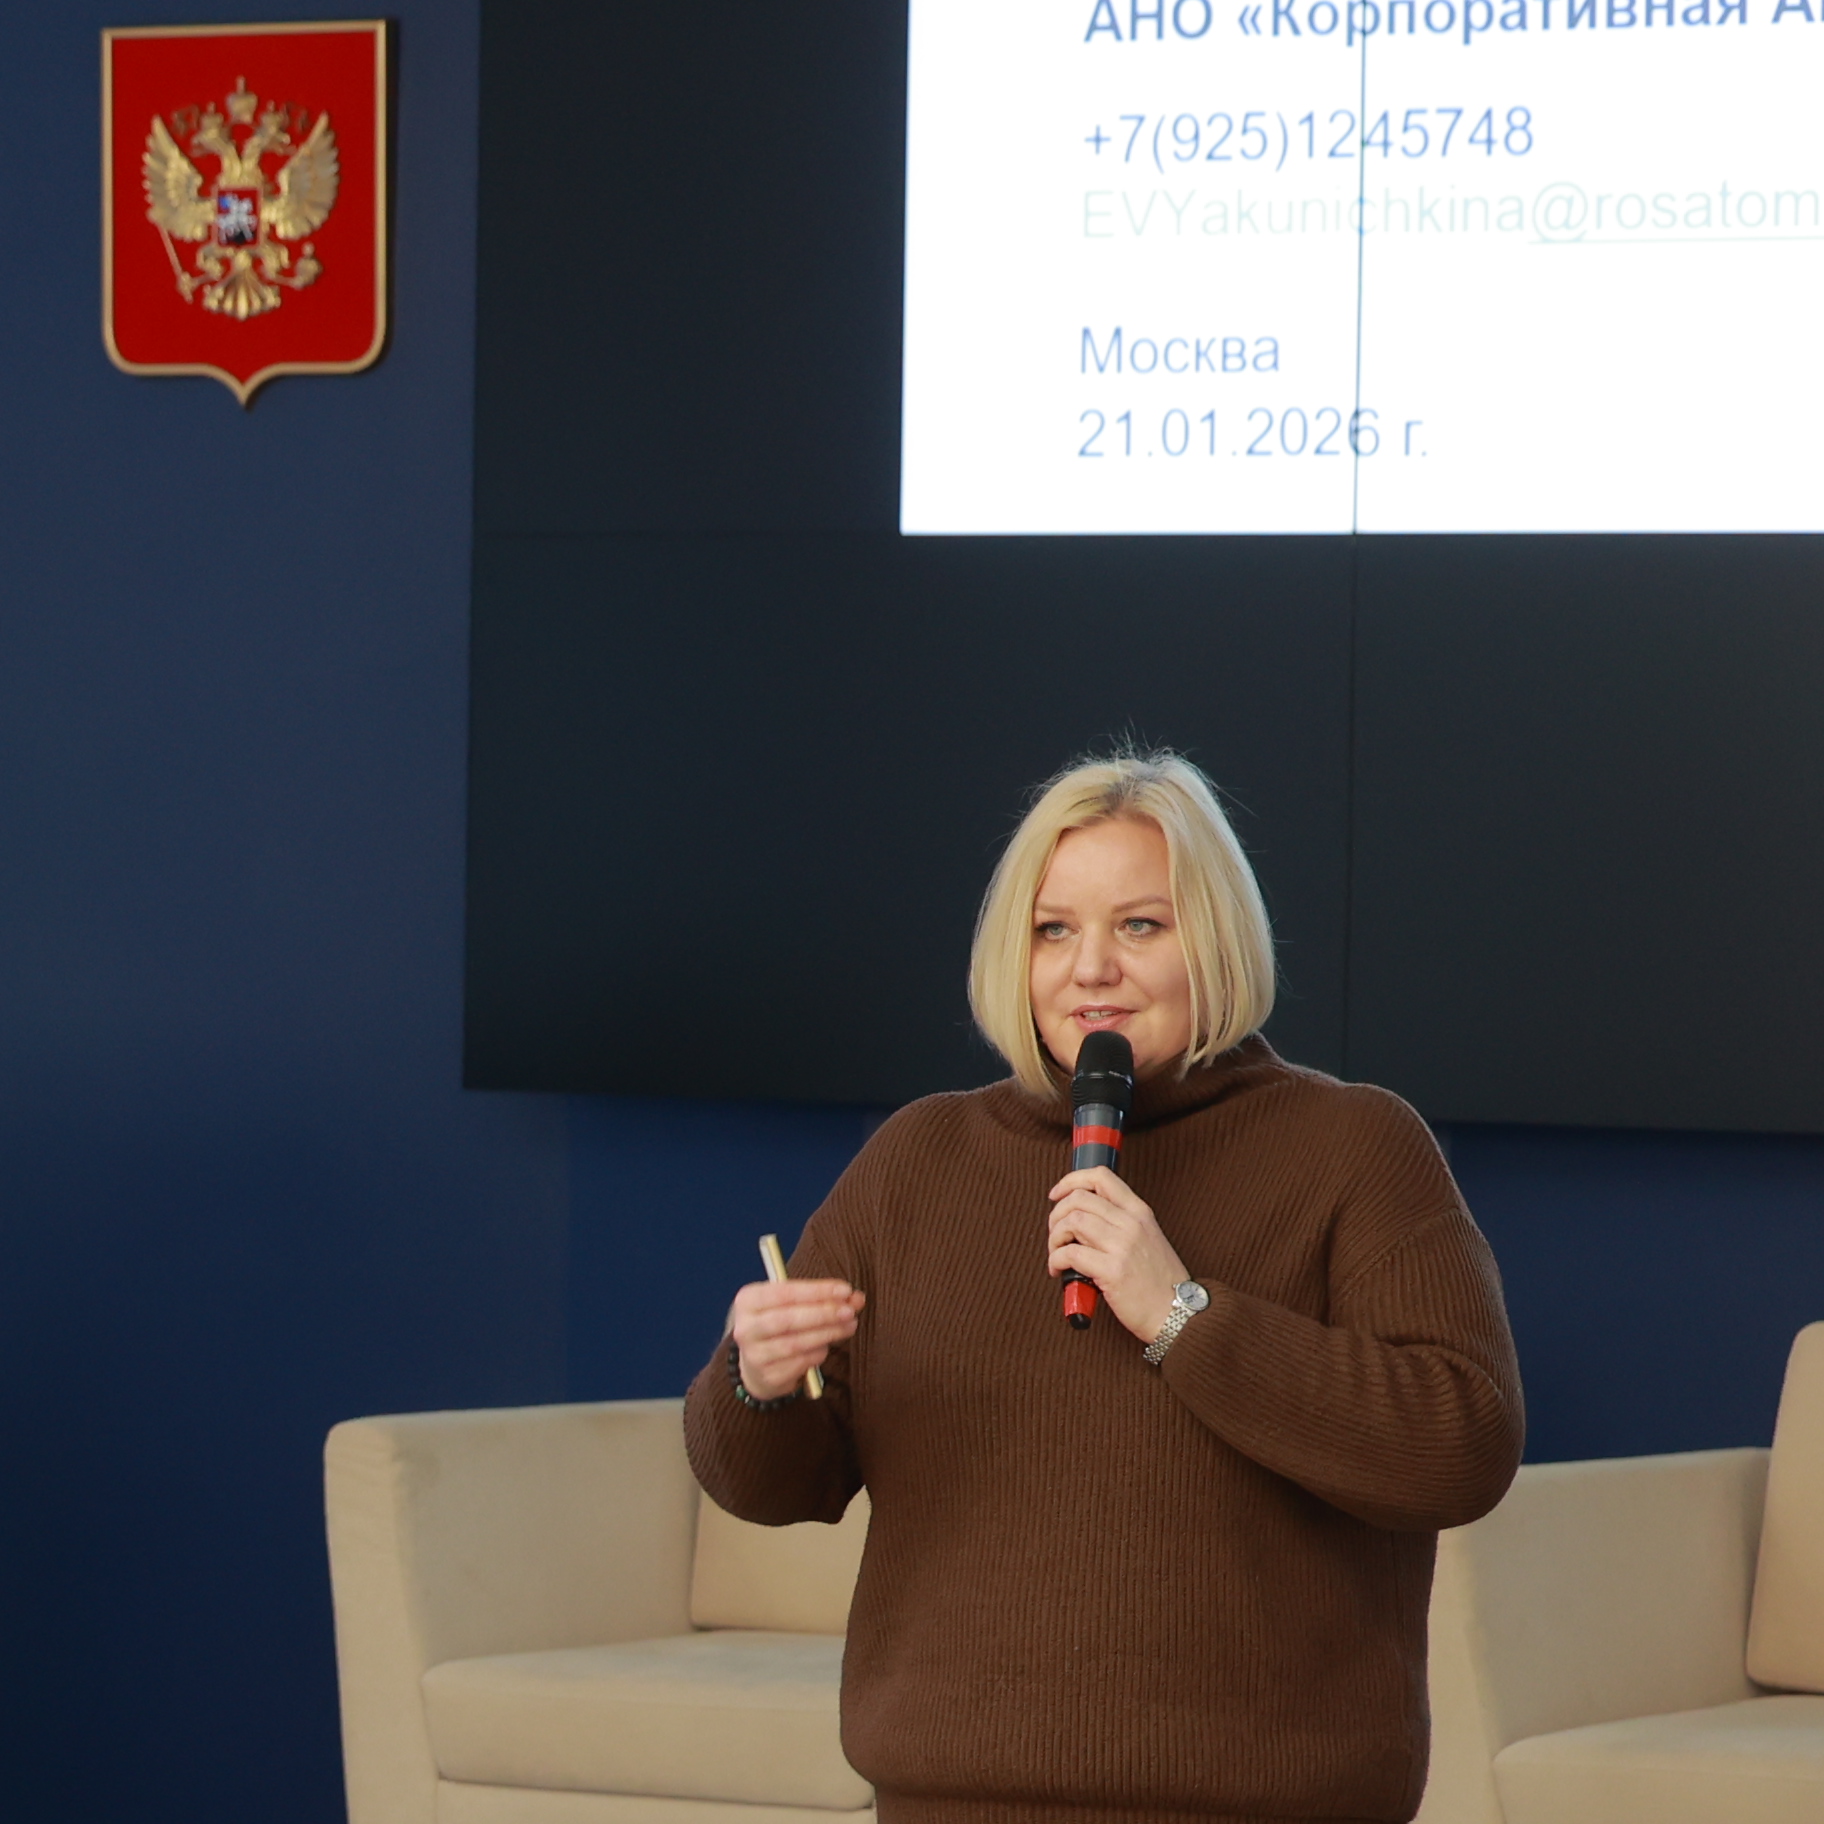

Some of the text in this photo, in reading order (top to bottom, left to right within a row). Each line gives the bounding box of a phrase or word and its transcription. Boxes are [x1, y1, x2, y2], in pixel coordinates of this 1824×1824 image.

[1084, 0, 1213, 42] АНО
[1084, 105, 1534, 175] +7(925)1245748
[1080, 325, 1280, 374] Москва
[1078, 406, 1428, 458] 21.01.2026 г.
